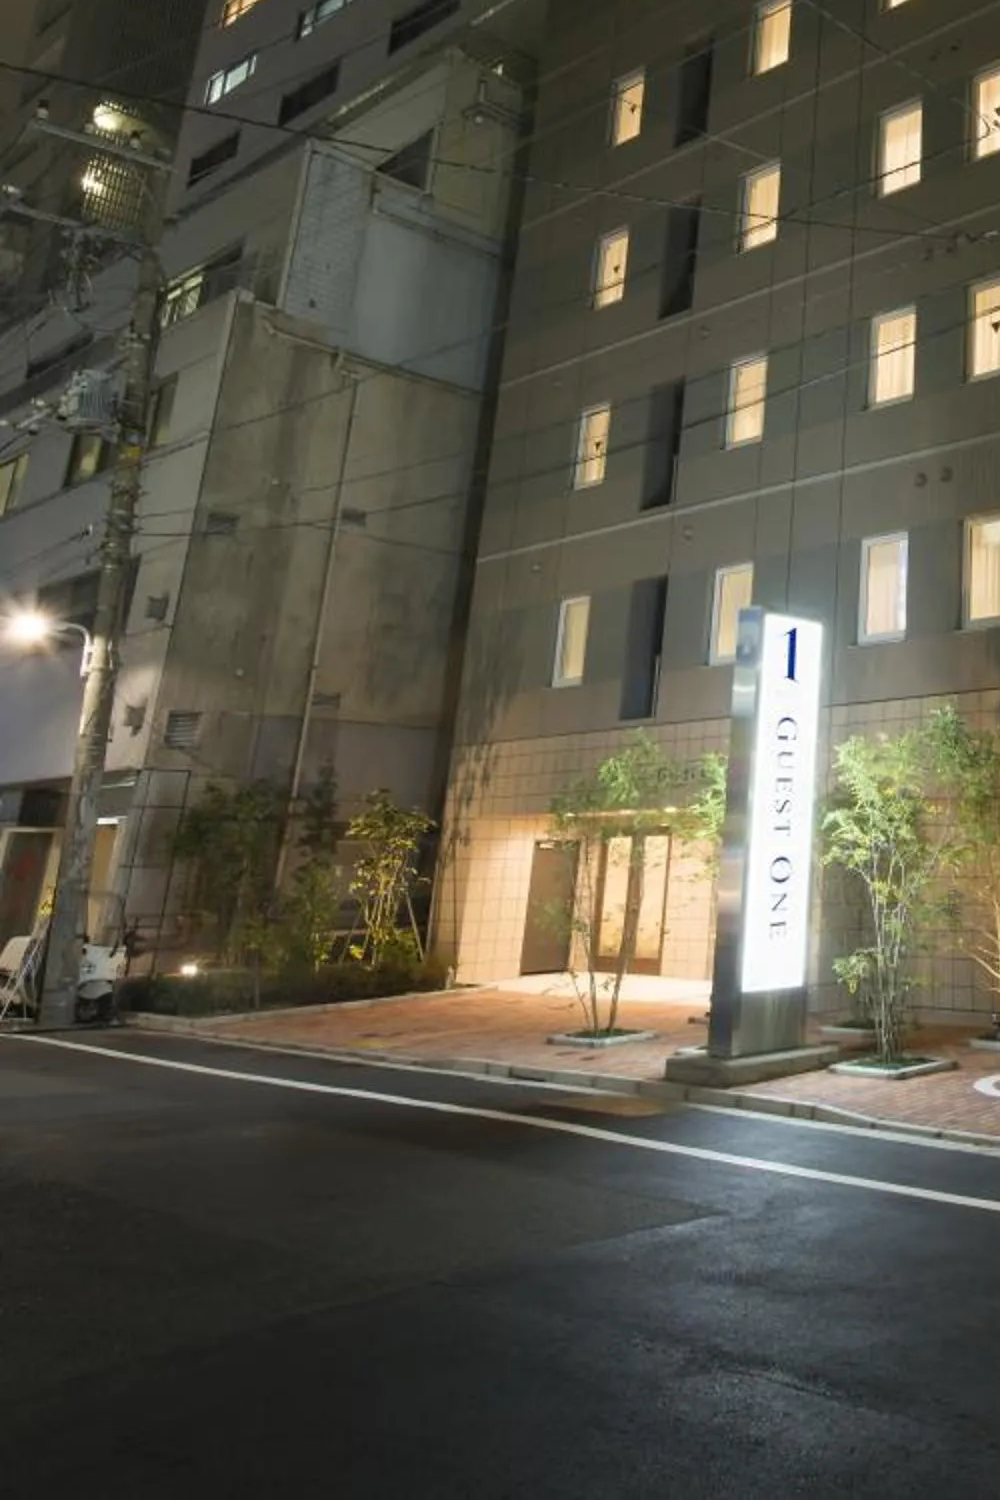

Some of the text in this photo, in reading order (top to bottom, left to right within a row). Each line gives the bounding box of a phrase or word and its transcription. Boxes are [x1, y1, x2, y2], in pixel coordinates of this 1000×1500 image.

[783, 627, 799, 683] 1
[769, 716, 798, 940] GUEST ONE
